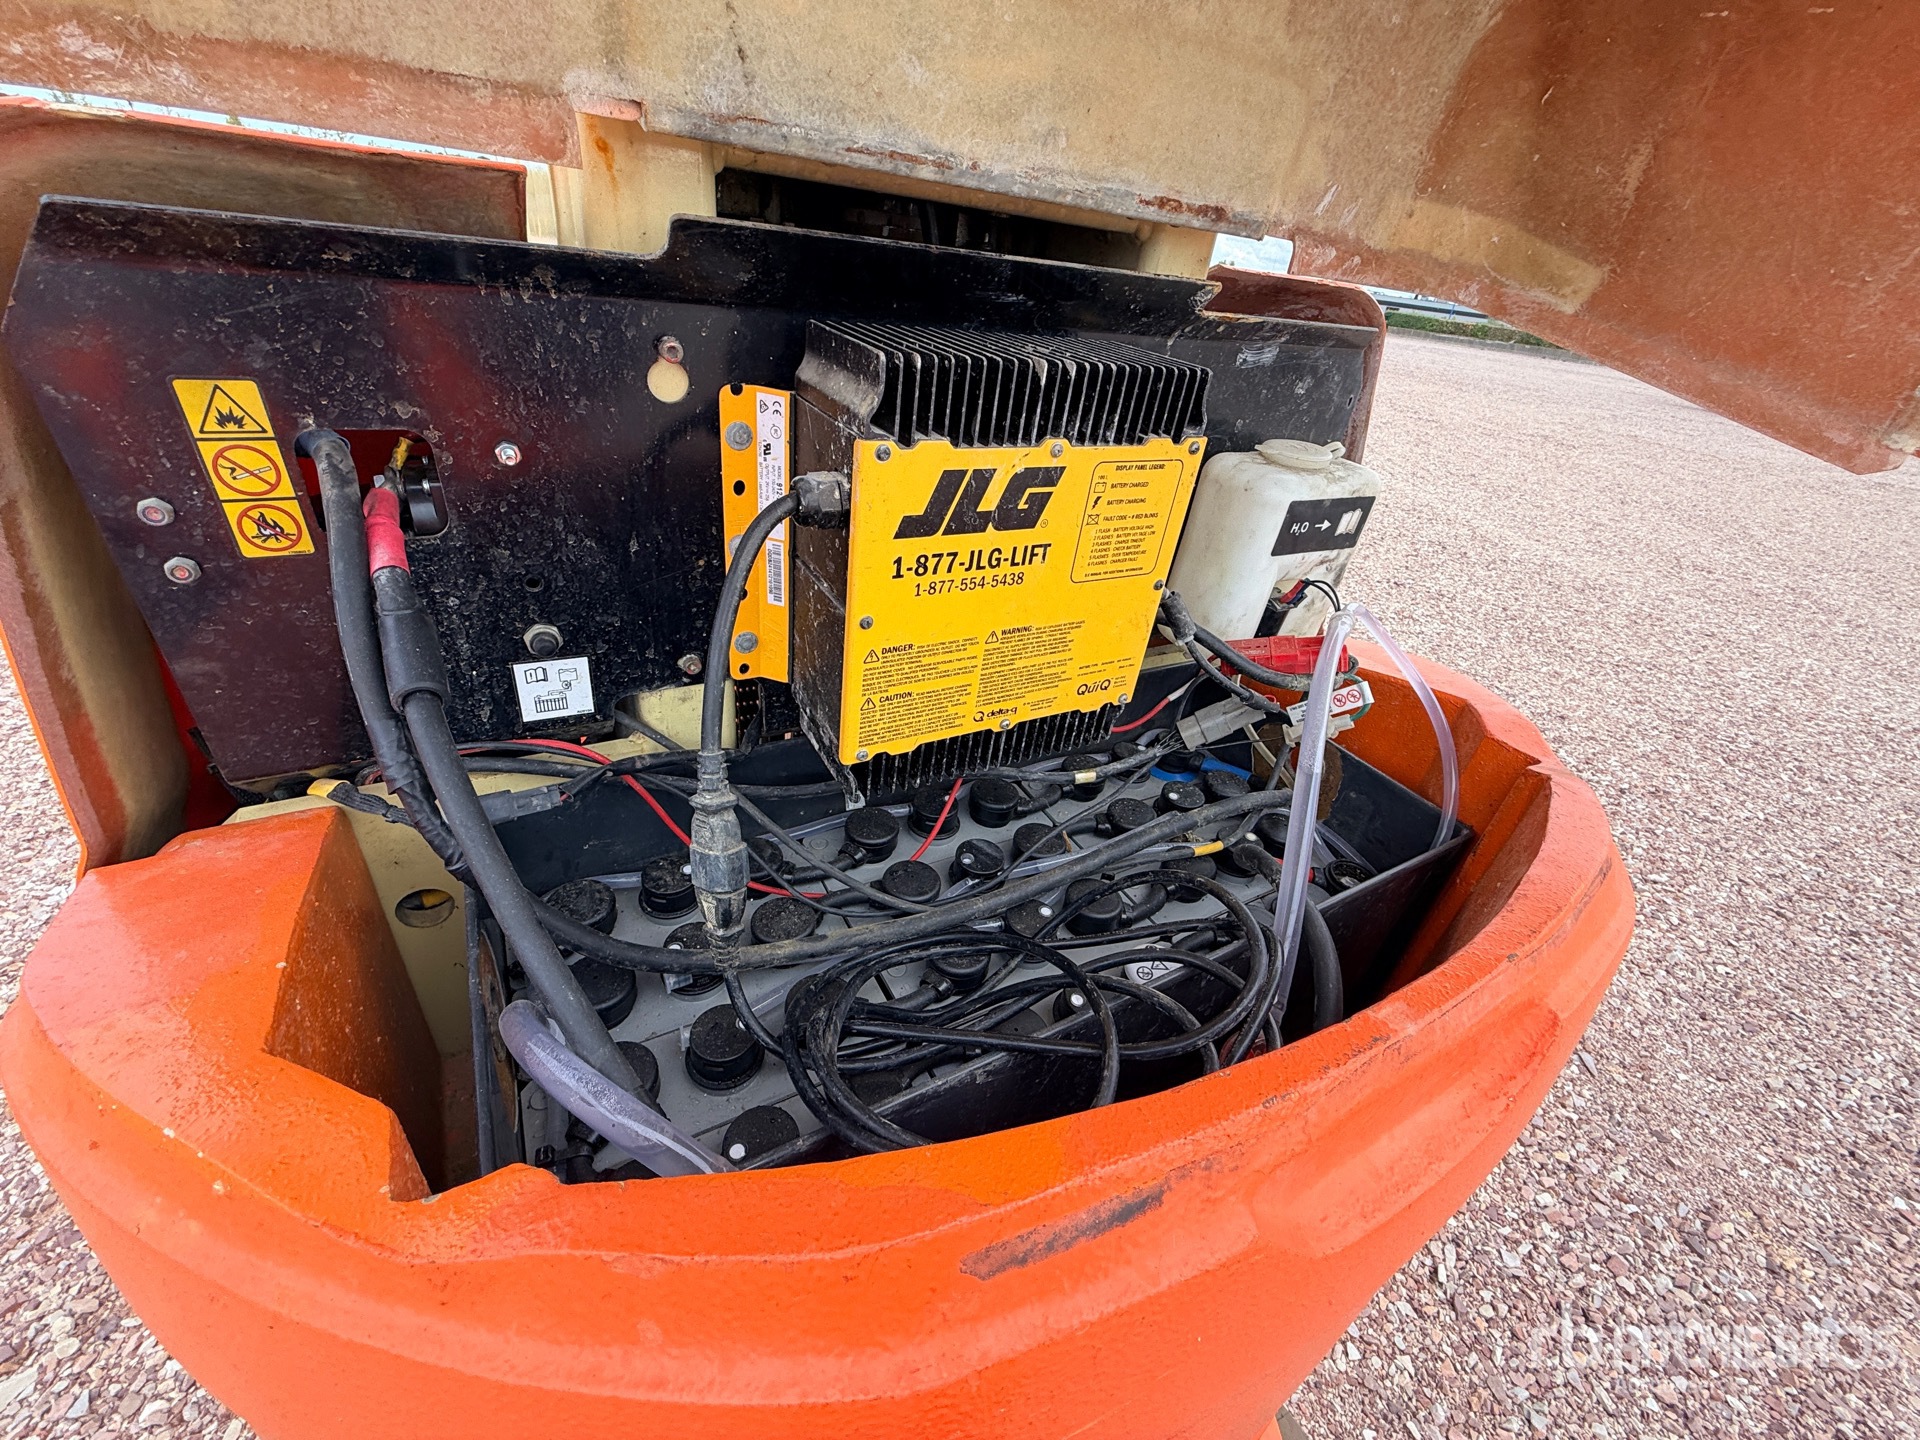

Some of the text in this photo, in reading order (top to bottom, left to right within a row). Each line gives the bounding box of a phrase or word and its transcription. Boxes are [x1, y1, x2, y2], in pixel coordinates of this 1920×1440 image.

[893, 466, 1067, 540] JLG
[891, 543, 1053, 580] 1-877-JLG-LIFT
[914, 572, 1026, 598] 1-877-554-5438
[1001, 626, 1035, 636] WARNING:
[882, 644, 917, 655] DANGER:
[880, 692, 915, 703] CAUTION:
[987, 707, 1018, 718] delta-q
